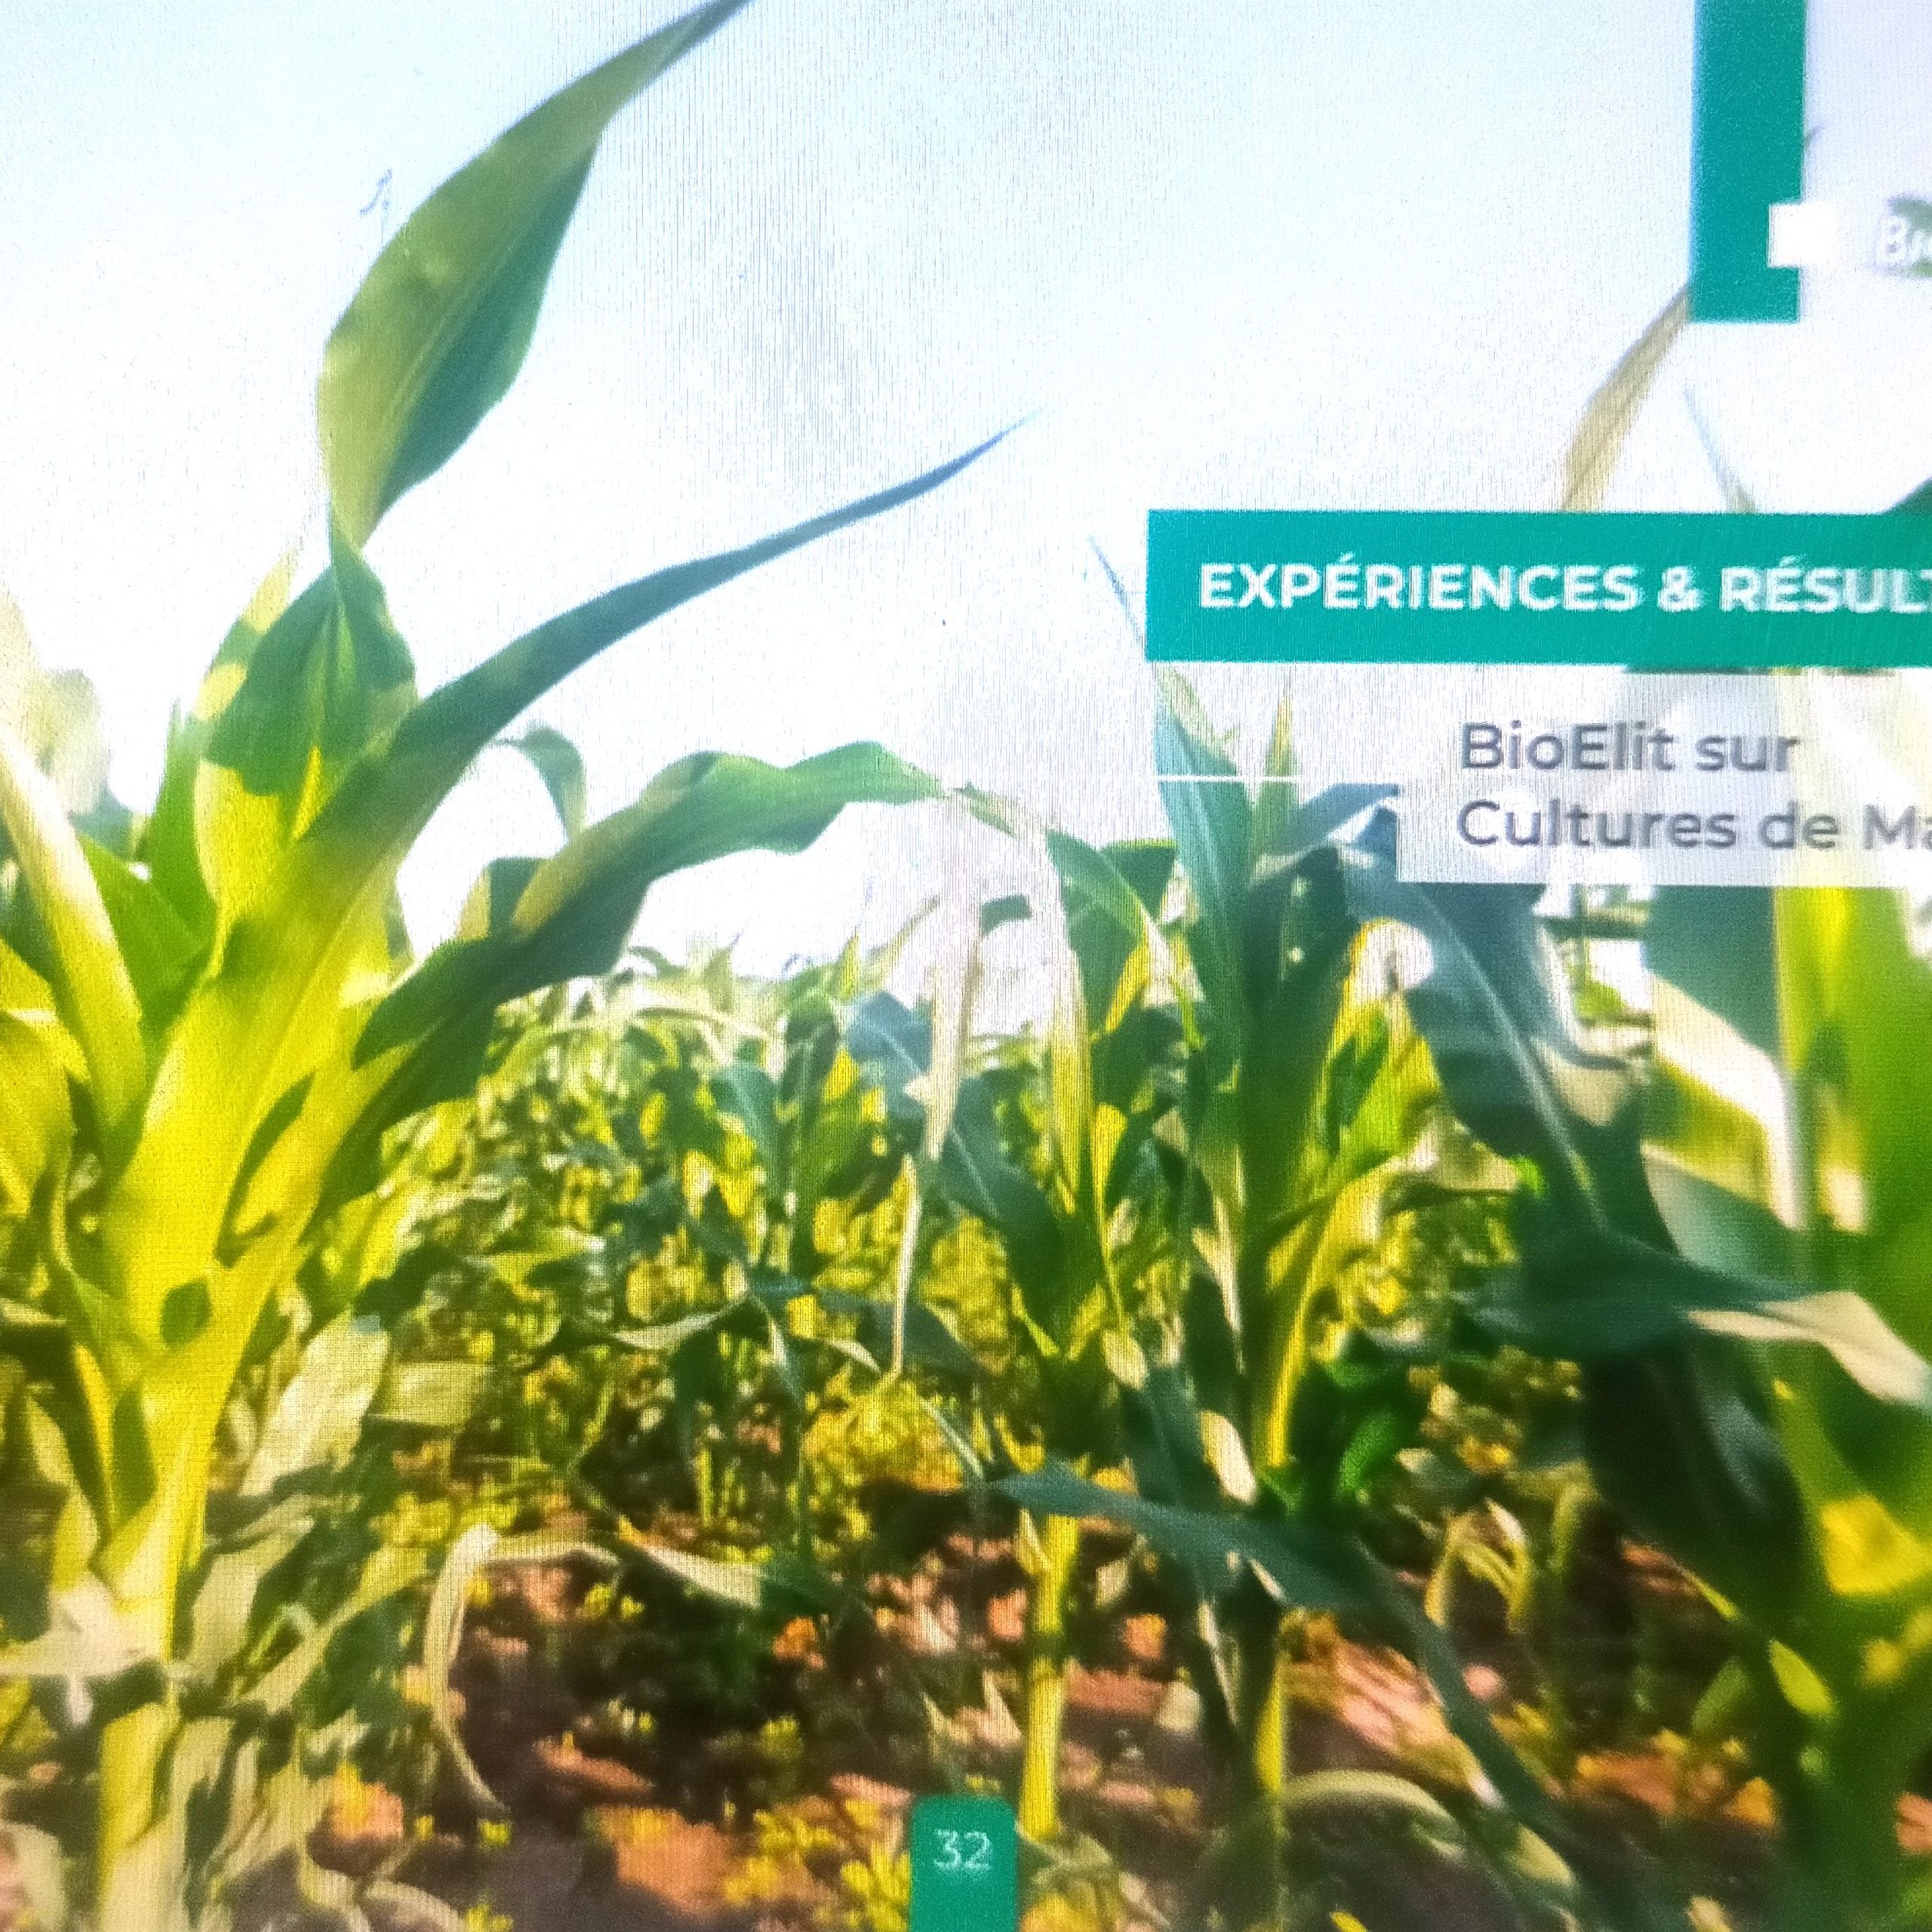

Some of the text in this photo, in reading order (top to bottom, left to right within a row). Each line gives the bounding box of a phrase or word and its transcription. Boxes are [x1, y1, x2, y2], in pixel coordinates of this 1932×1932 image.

[1199, 551, 1643, 613] EXPÉRIENCES
[1658, 566, 1705, 612] &
[1462, 719, 1801, 771] BioElit sur
[1457, 798, 1737, 850] Cultures
[1758, 800, 1839, 851] de
[934, 1829, 991, 1871] 32
